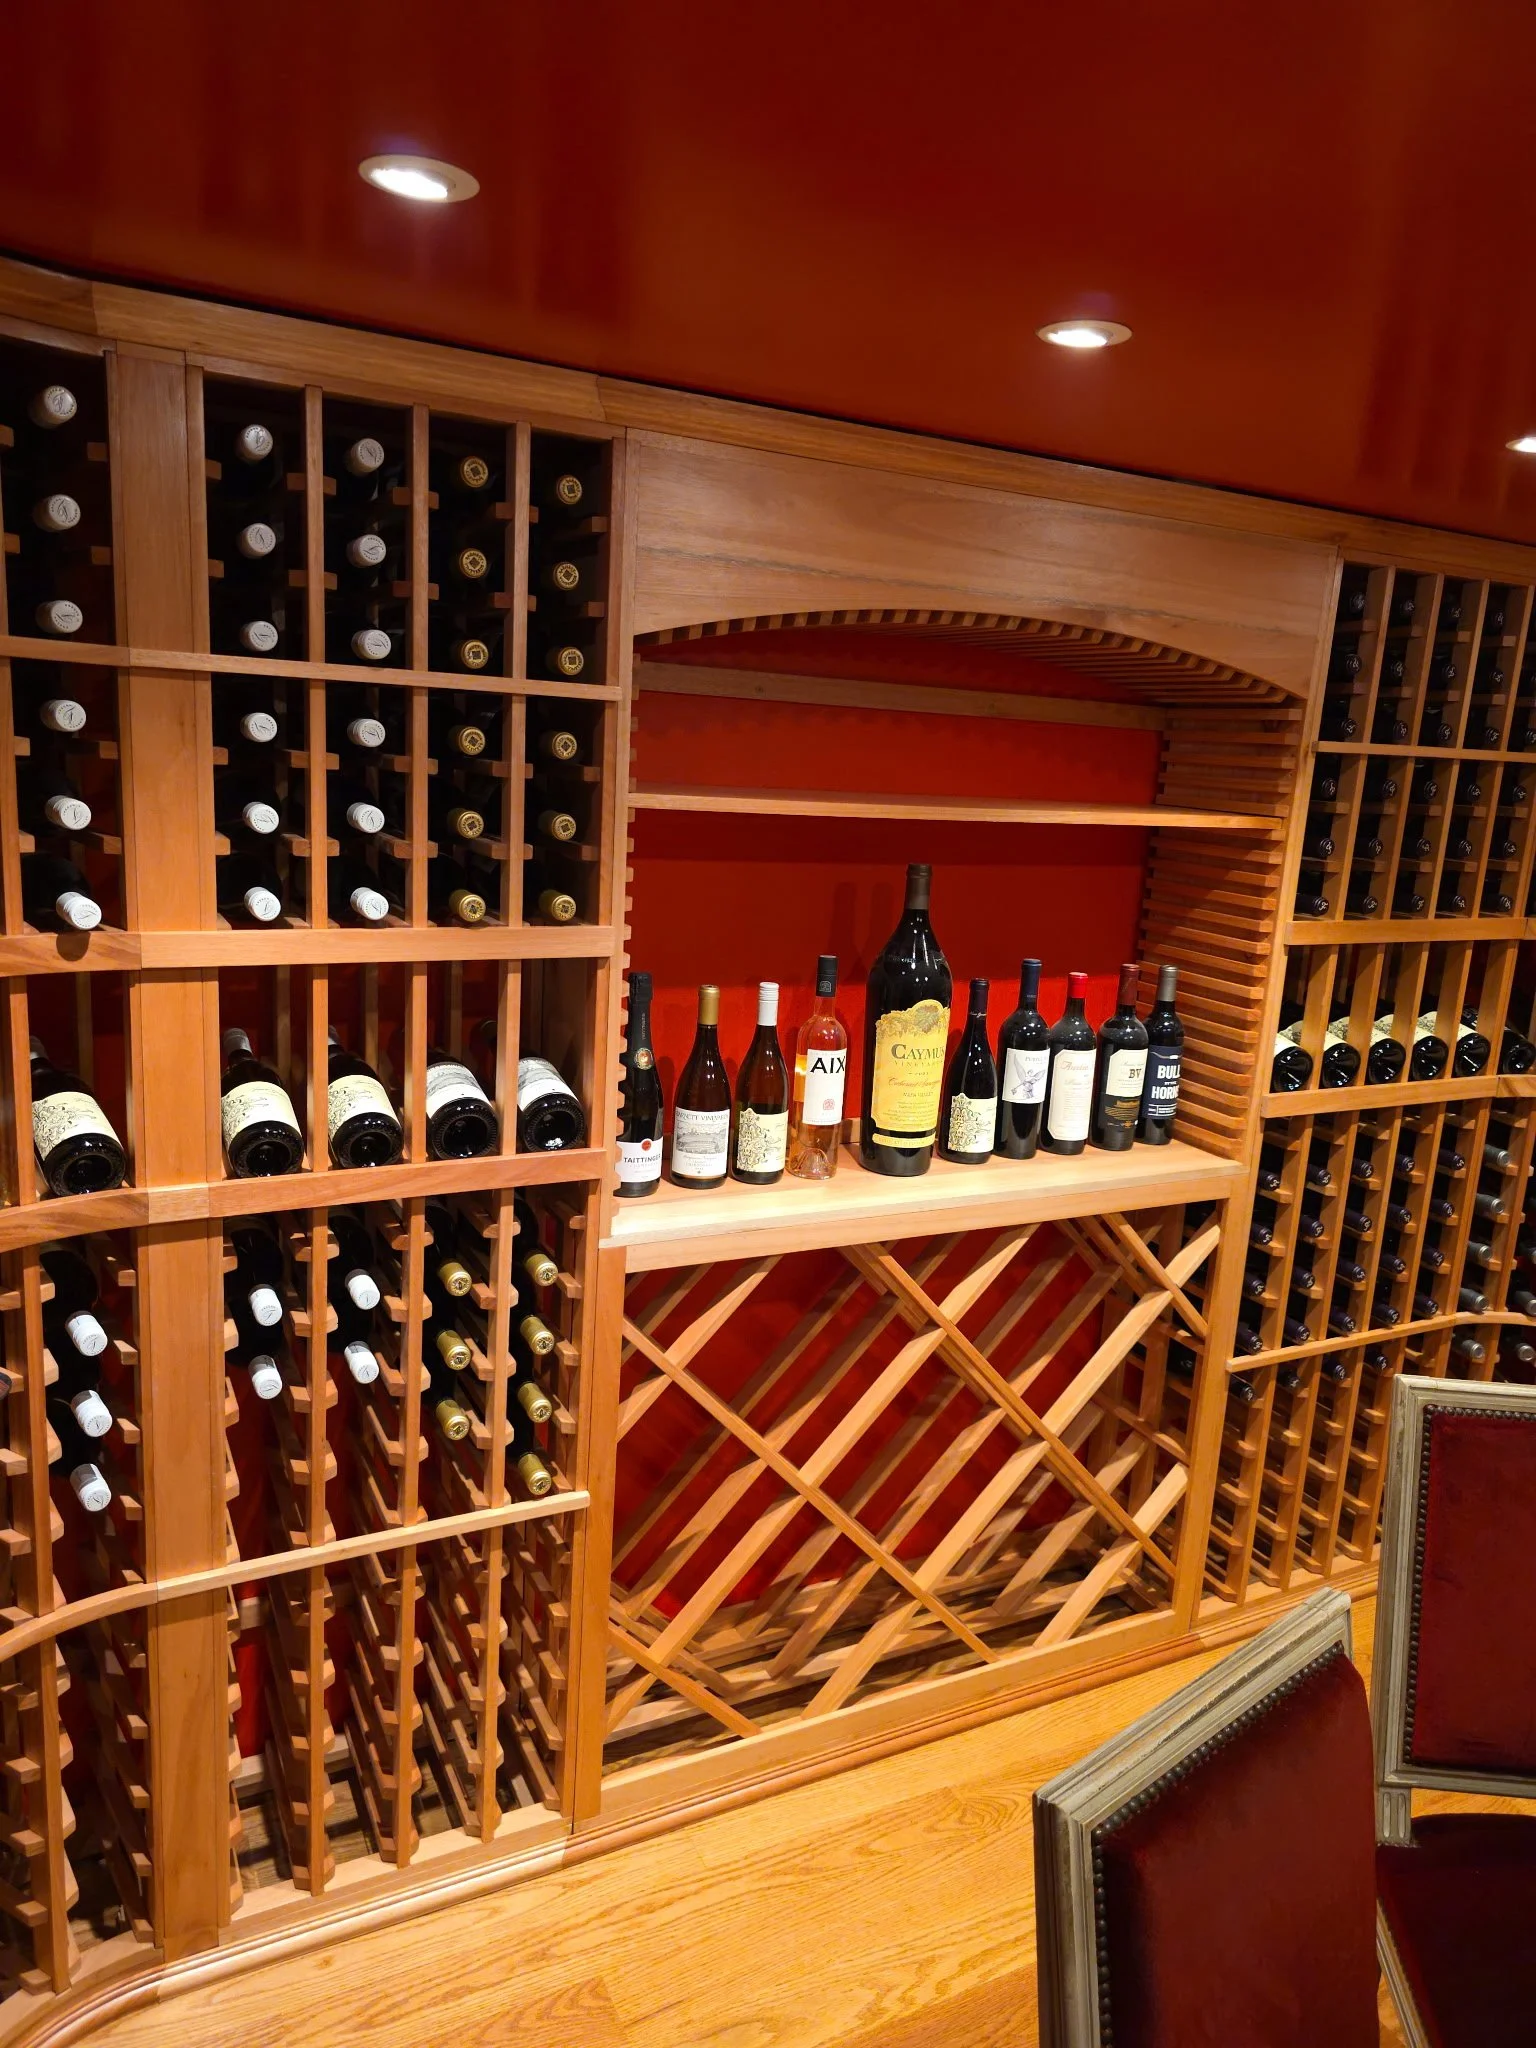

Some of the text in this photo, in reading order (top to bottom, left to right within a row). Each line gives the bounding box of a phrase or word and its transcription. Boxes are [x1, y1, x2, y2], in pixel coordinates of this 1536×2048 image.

[891, 1043, 945, 1060] CAYMUS
[810, 1056, 846, 1074] AIX
[1128, 1068, 1142, 1079] BV
